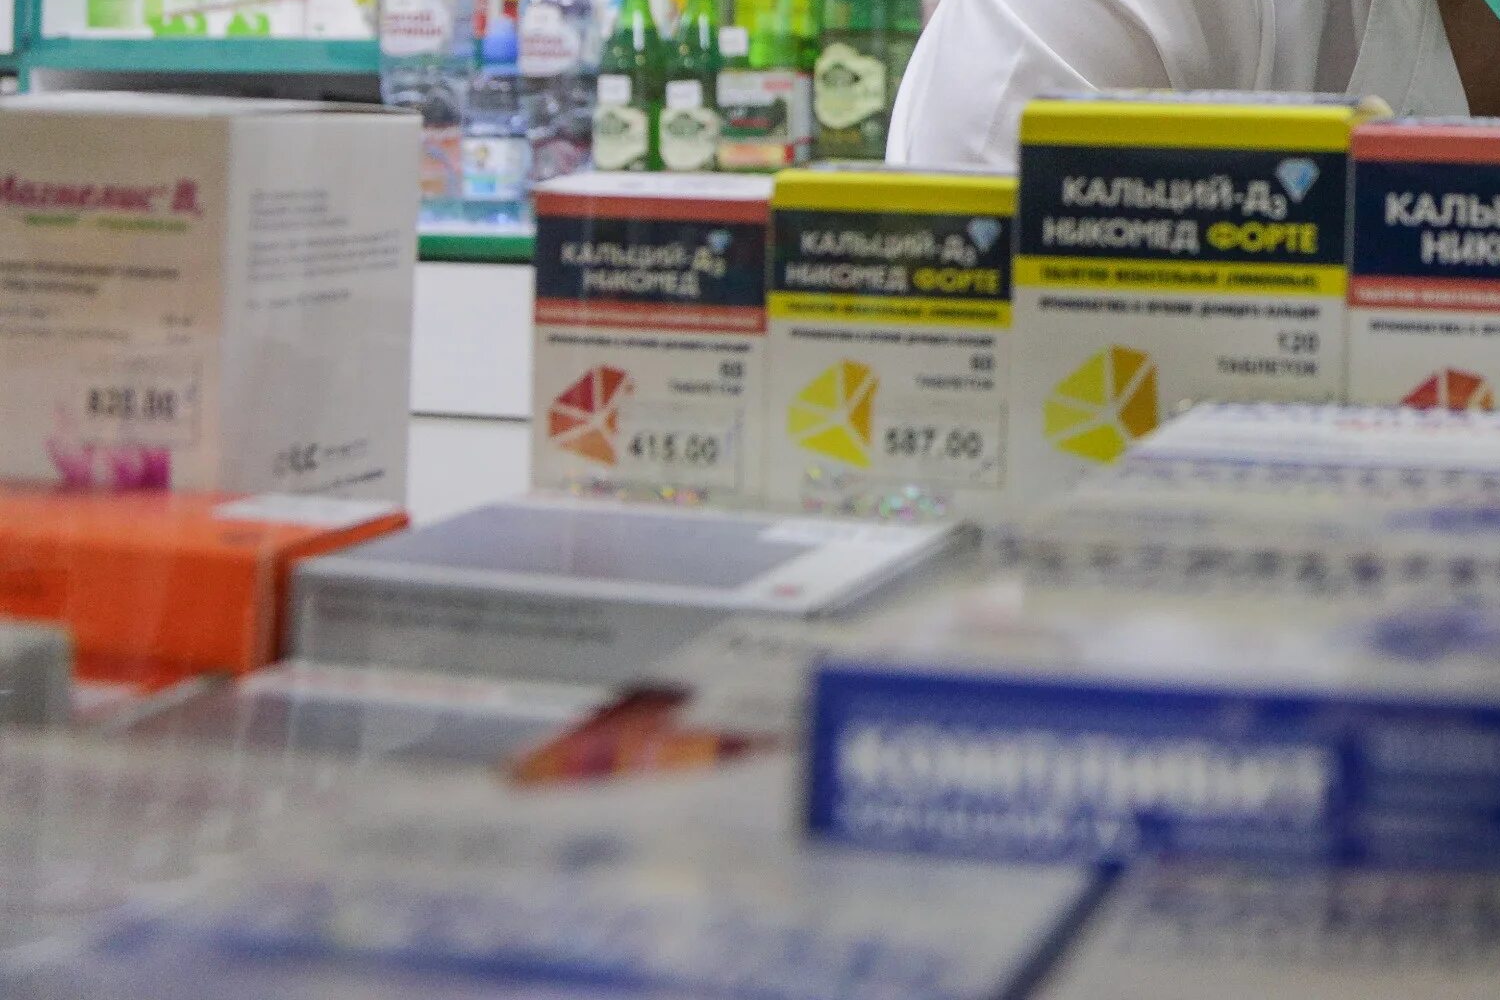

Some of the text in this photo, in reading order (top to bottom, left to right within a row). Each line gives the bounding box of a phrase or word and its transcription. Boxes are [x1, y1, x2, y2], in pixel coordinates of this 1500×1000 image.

[1042, 216, 1319, 255] НИКОМЕД ФОРТЕ
[583, 269, 700, 297] НИКОМЕД
[785, 262, 1000, 296] НИКОМЕД ФОРТЕ
[629, 433, 719, 464] 415.00
[884, 426, 984, 460] 587.00
